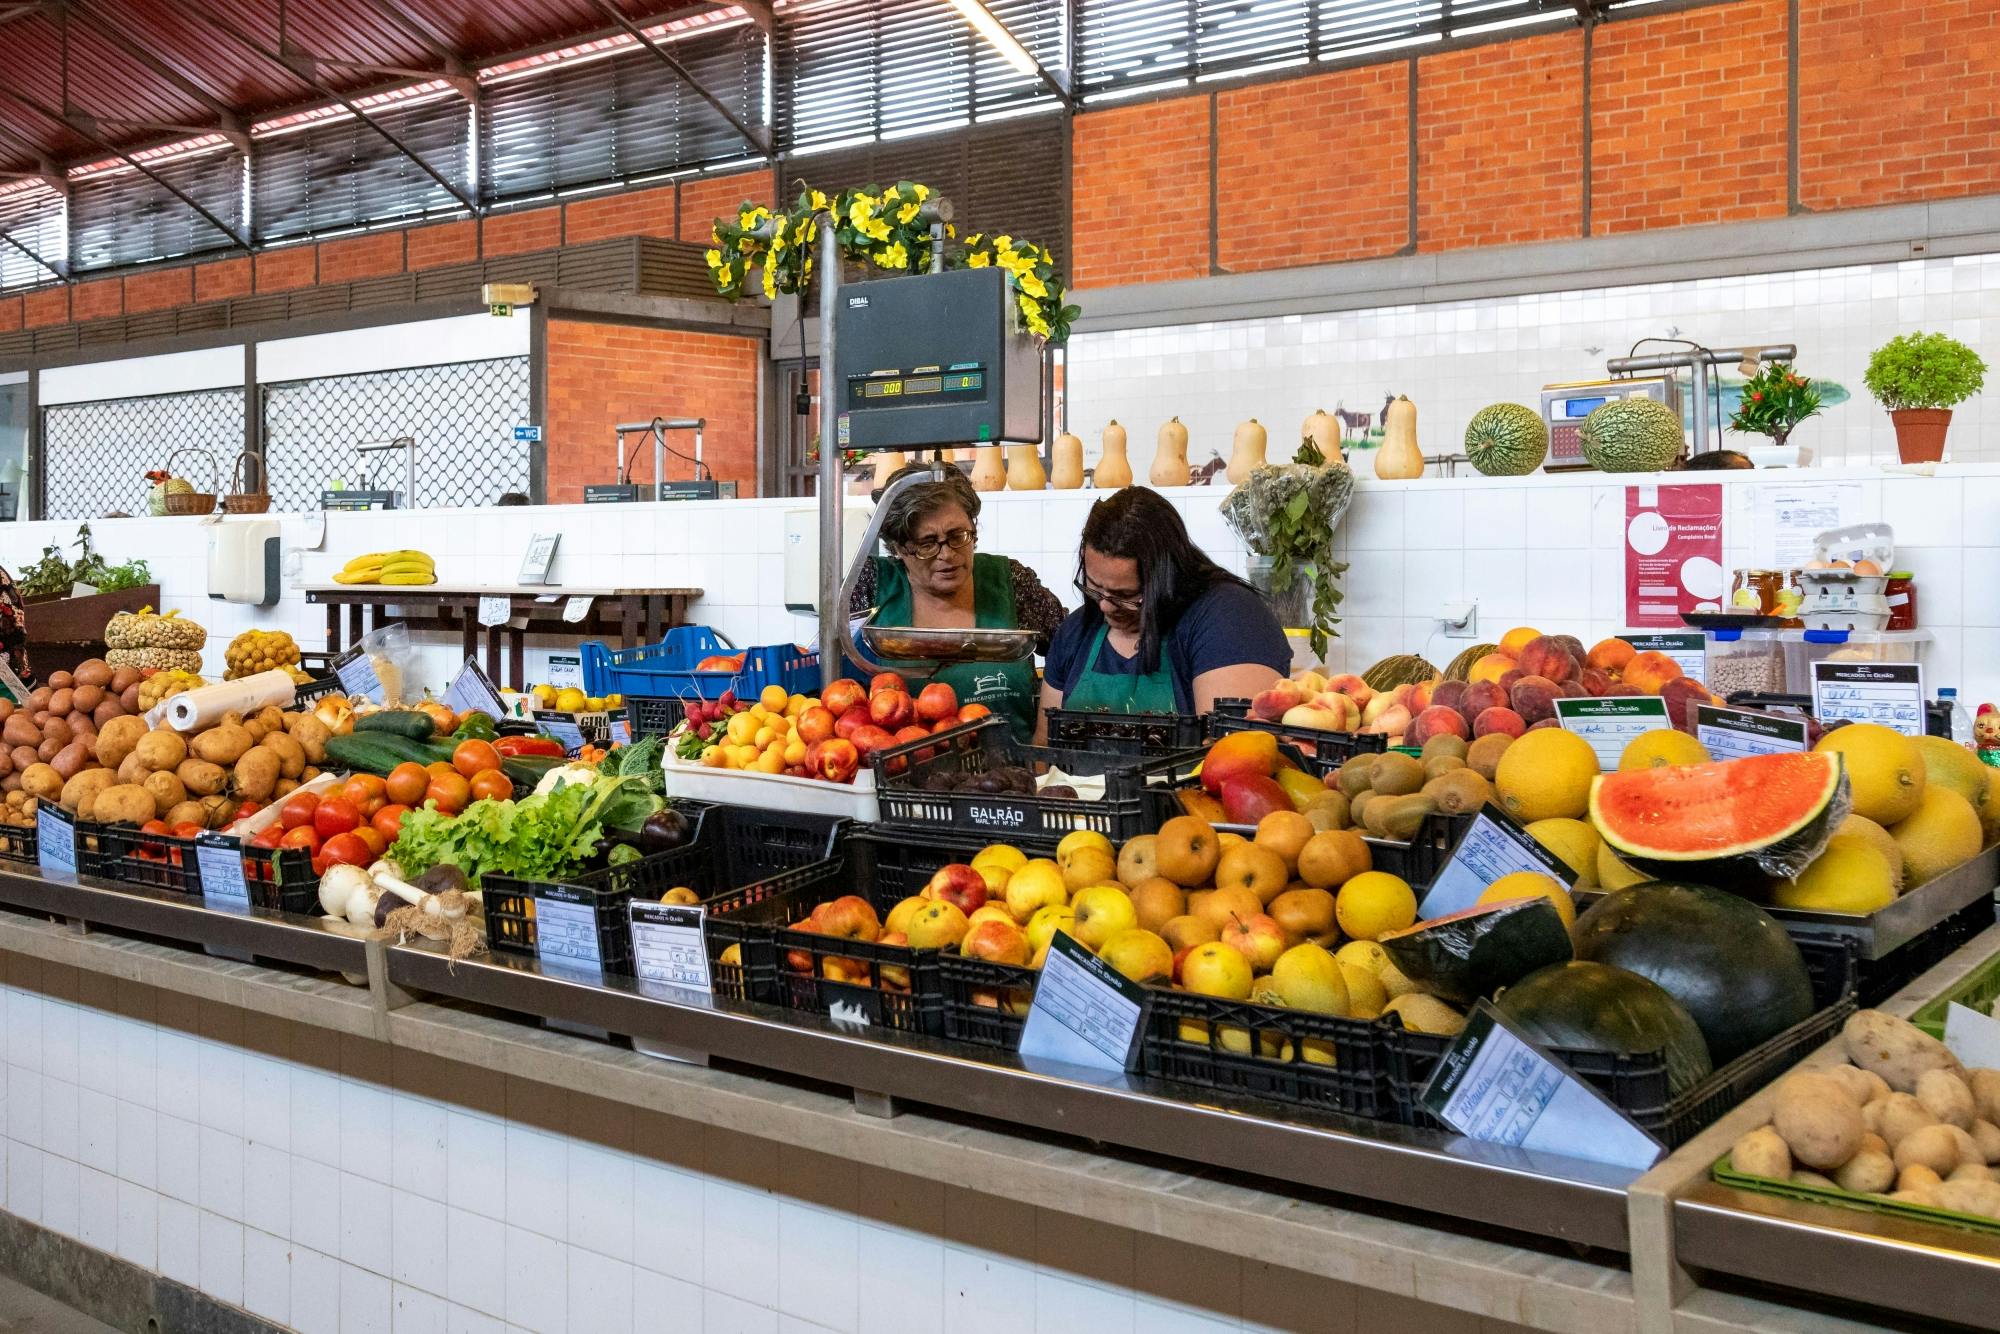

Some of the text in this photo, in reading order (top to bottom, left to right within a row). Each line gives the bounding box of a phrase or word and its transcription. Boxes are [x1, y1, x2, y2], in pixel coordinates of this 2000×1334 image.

[850, 297, 868, 305] DIBAL
[525, 429, 537, 438] WC
[1677, 524, 1717, 532] Reclamações
[970, 806, 1024, 822] GALRÃO
[1500, 820, 1526, 847] MERCADOS
[644, 913, 664, 921] MERCADOS
[1069, 948, 1098, 971] MERCADOS
[1103, 971, 1123, 988] OLHÃO
[1441, 1063, 1464, 1093] MERCADOS
[1464, 1036, 1478, 1057] OLHÃO
